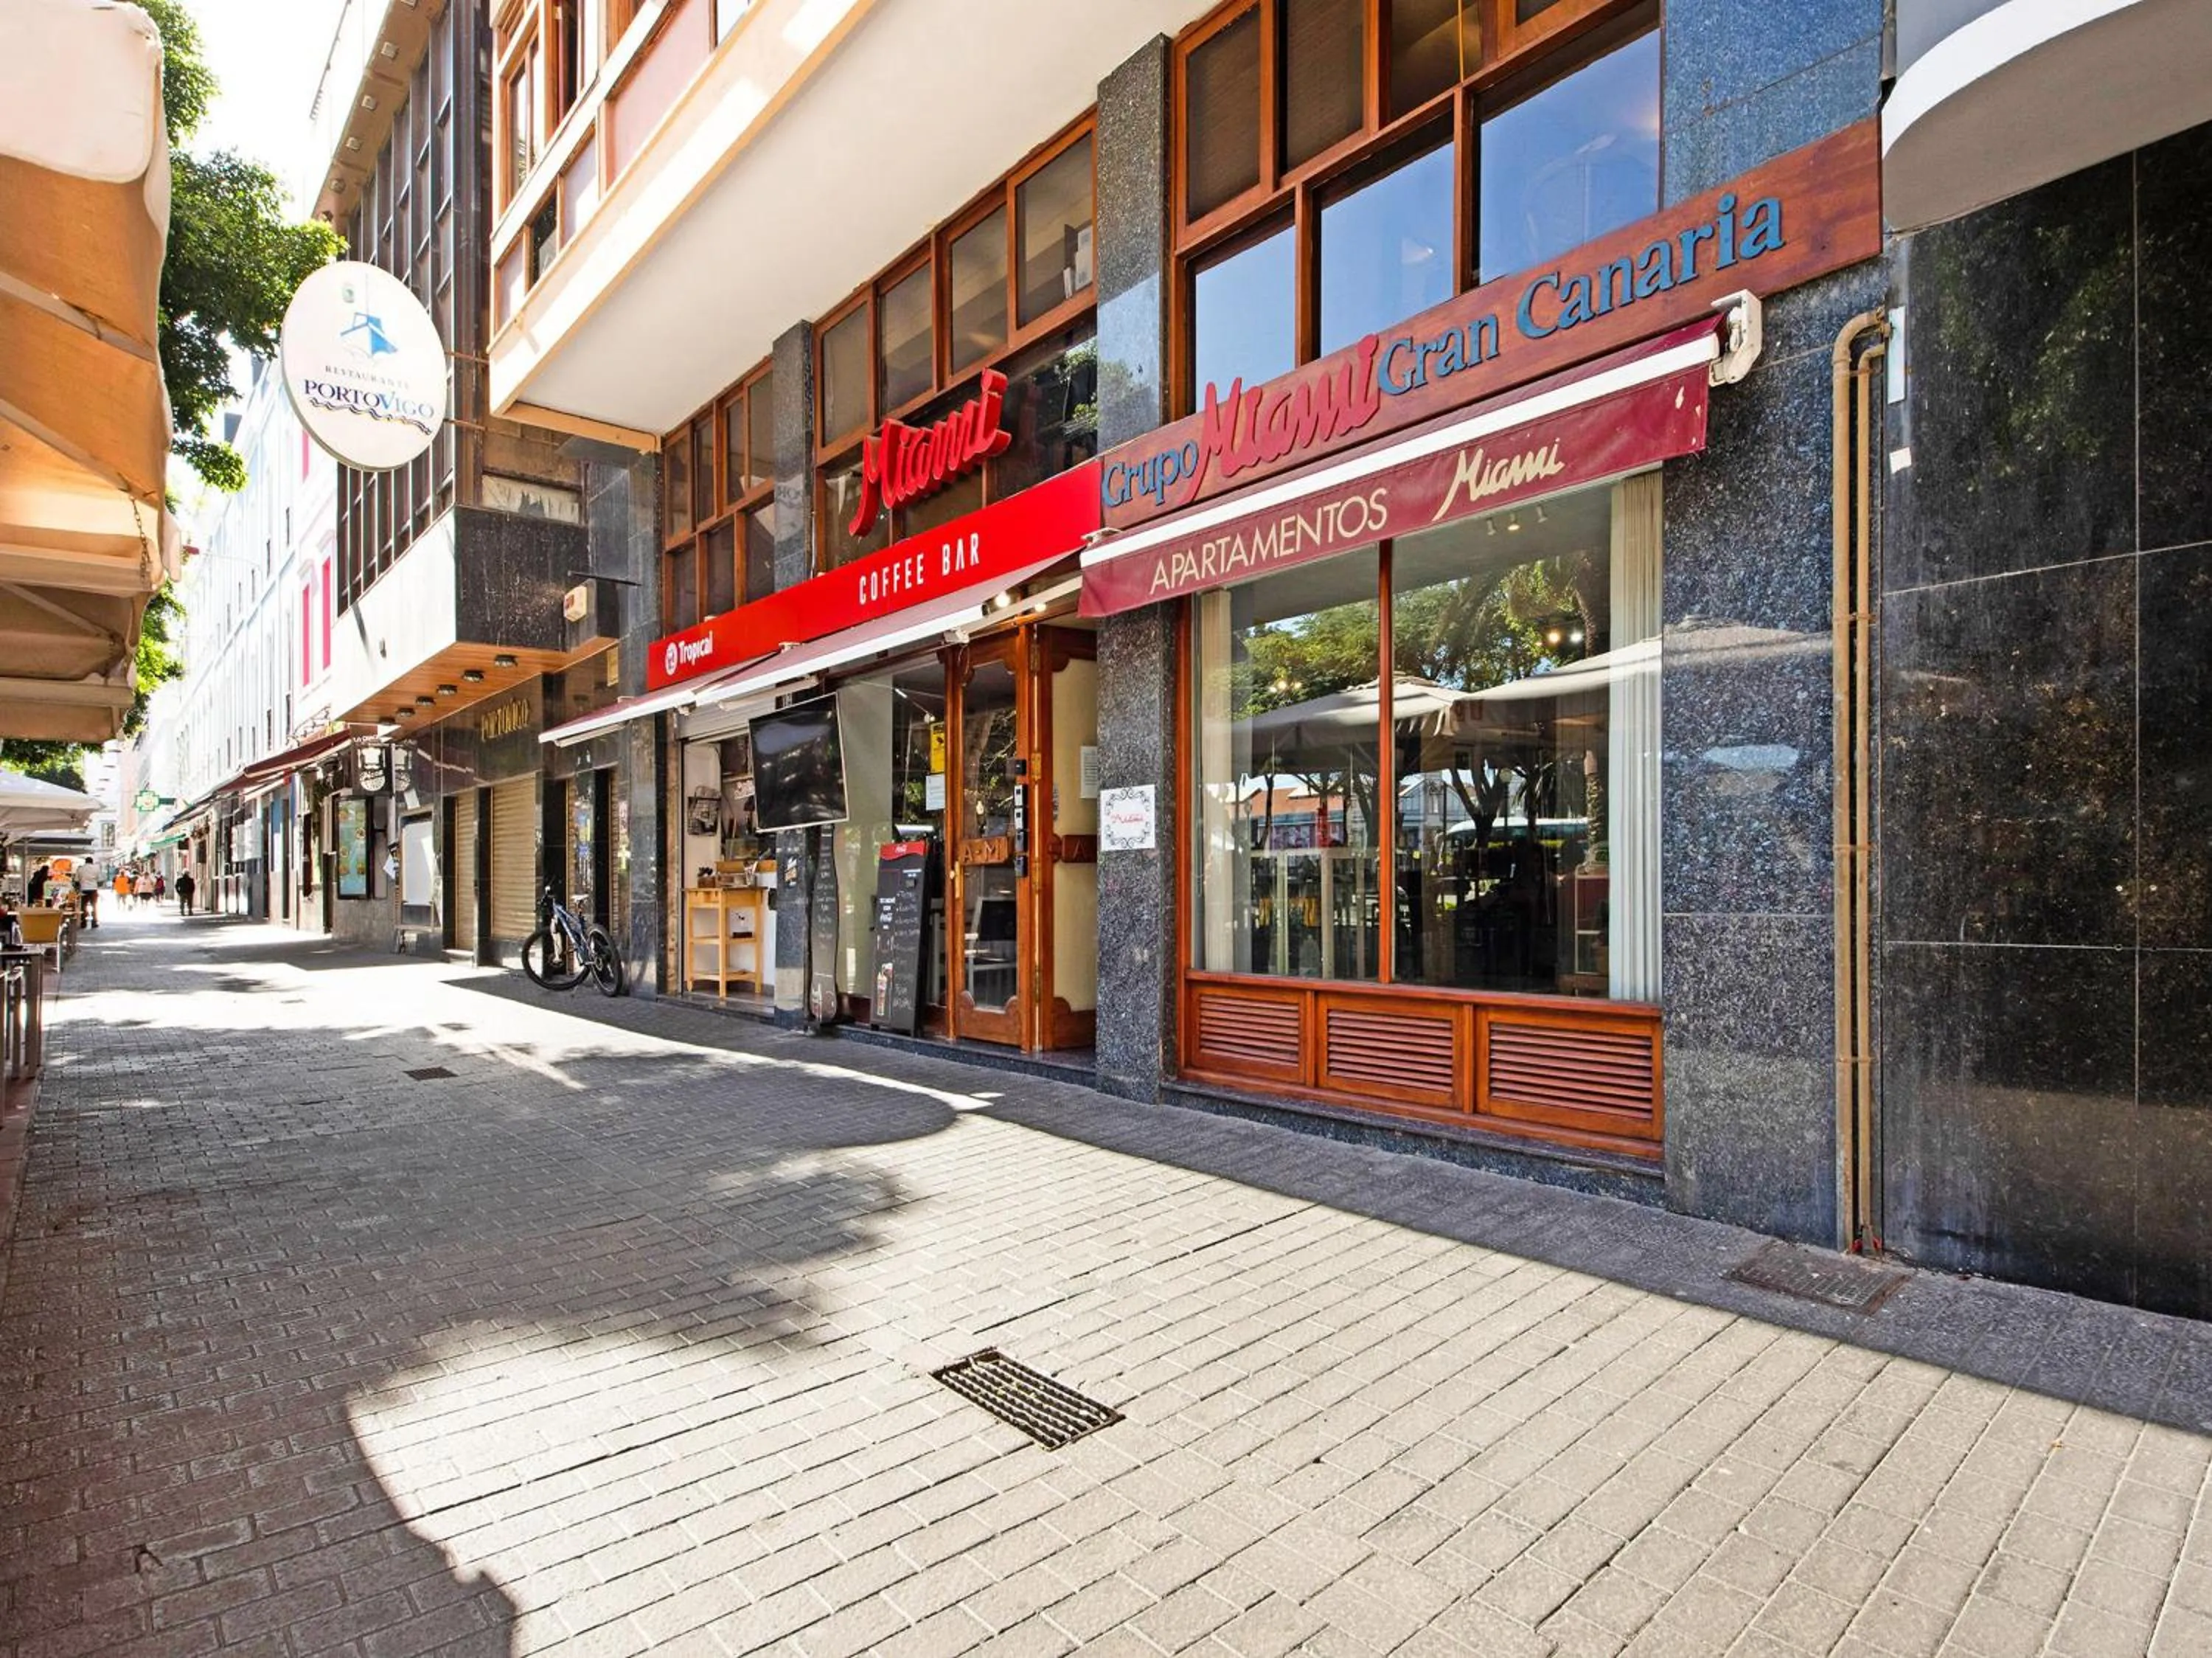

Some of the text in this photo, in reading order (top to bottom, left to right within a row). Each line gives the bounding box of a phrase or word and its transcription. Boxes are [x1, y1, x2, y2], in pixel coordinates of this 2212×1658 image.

[304, 378, 435, 418] PORTOVIGO
[1102, 192, 1785, 508] Grupo Miami Gran Canaria
[849, 367, 1012, 538] Miami
[858, 533, 980, 606] COFFEE BAR
[1150, 438, 1565, 594] APARTAMENTOS Miami
[678, 629, 714, 666] Tropical
